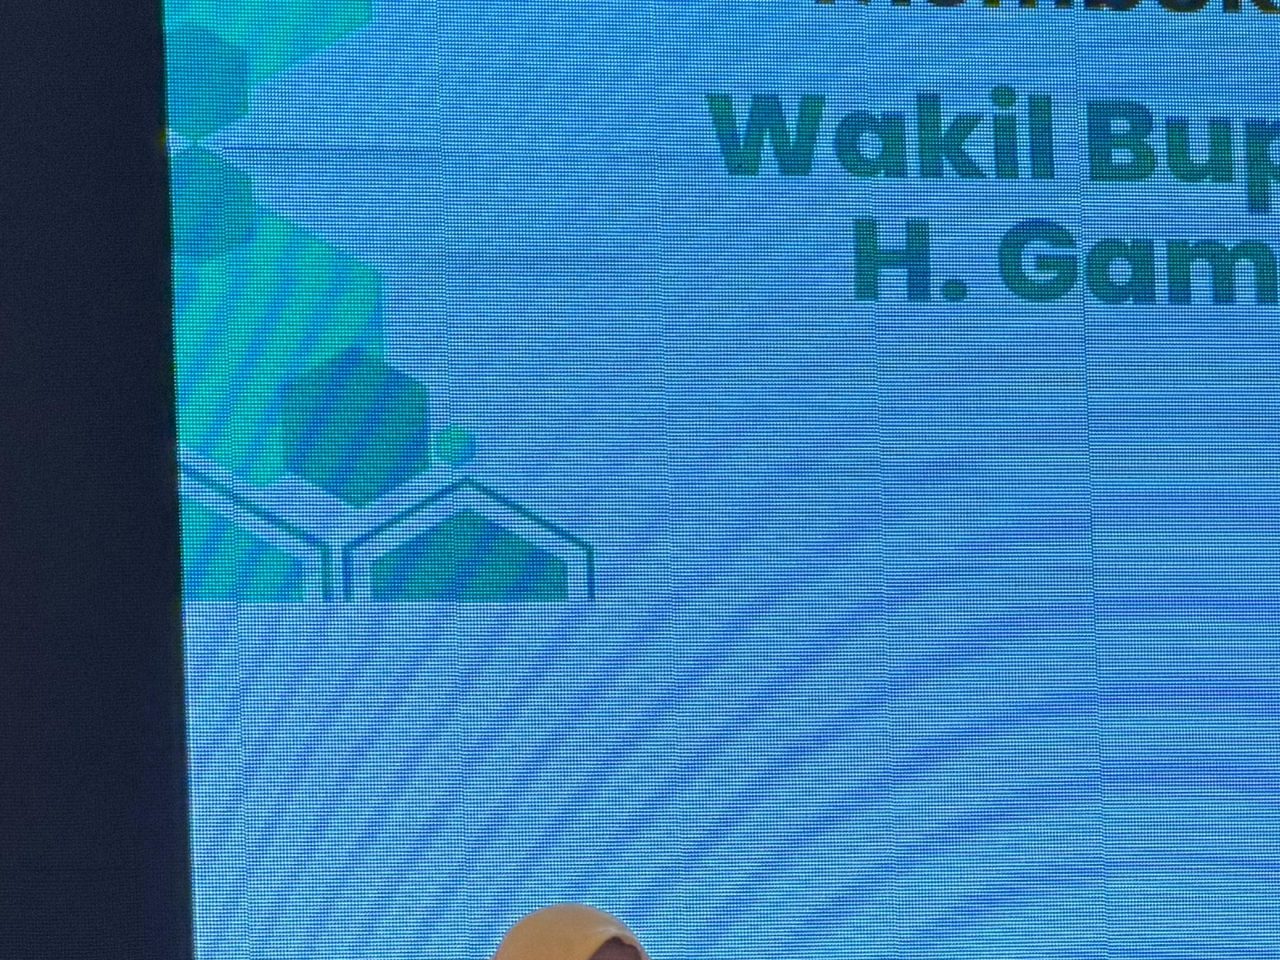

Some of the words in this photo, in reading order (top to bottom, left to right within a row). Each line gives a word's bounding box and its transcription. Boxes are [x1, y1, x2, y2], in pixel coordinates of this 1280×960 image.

[705, 85, 1055, 181] Wakil
[853, 218, 968, 302] H.
[997, 218, 1279, 305] Gam
